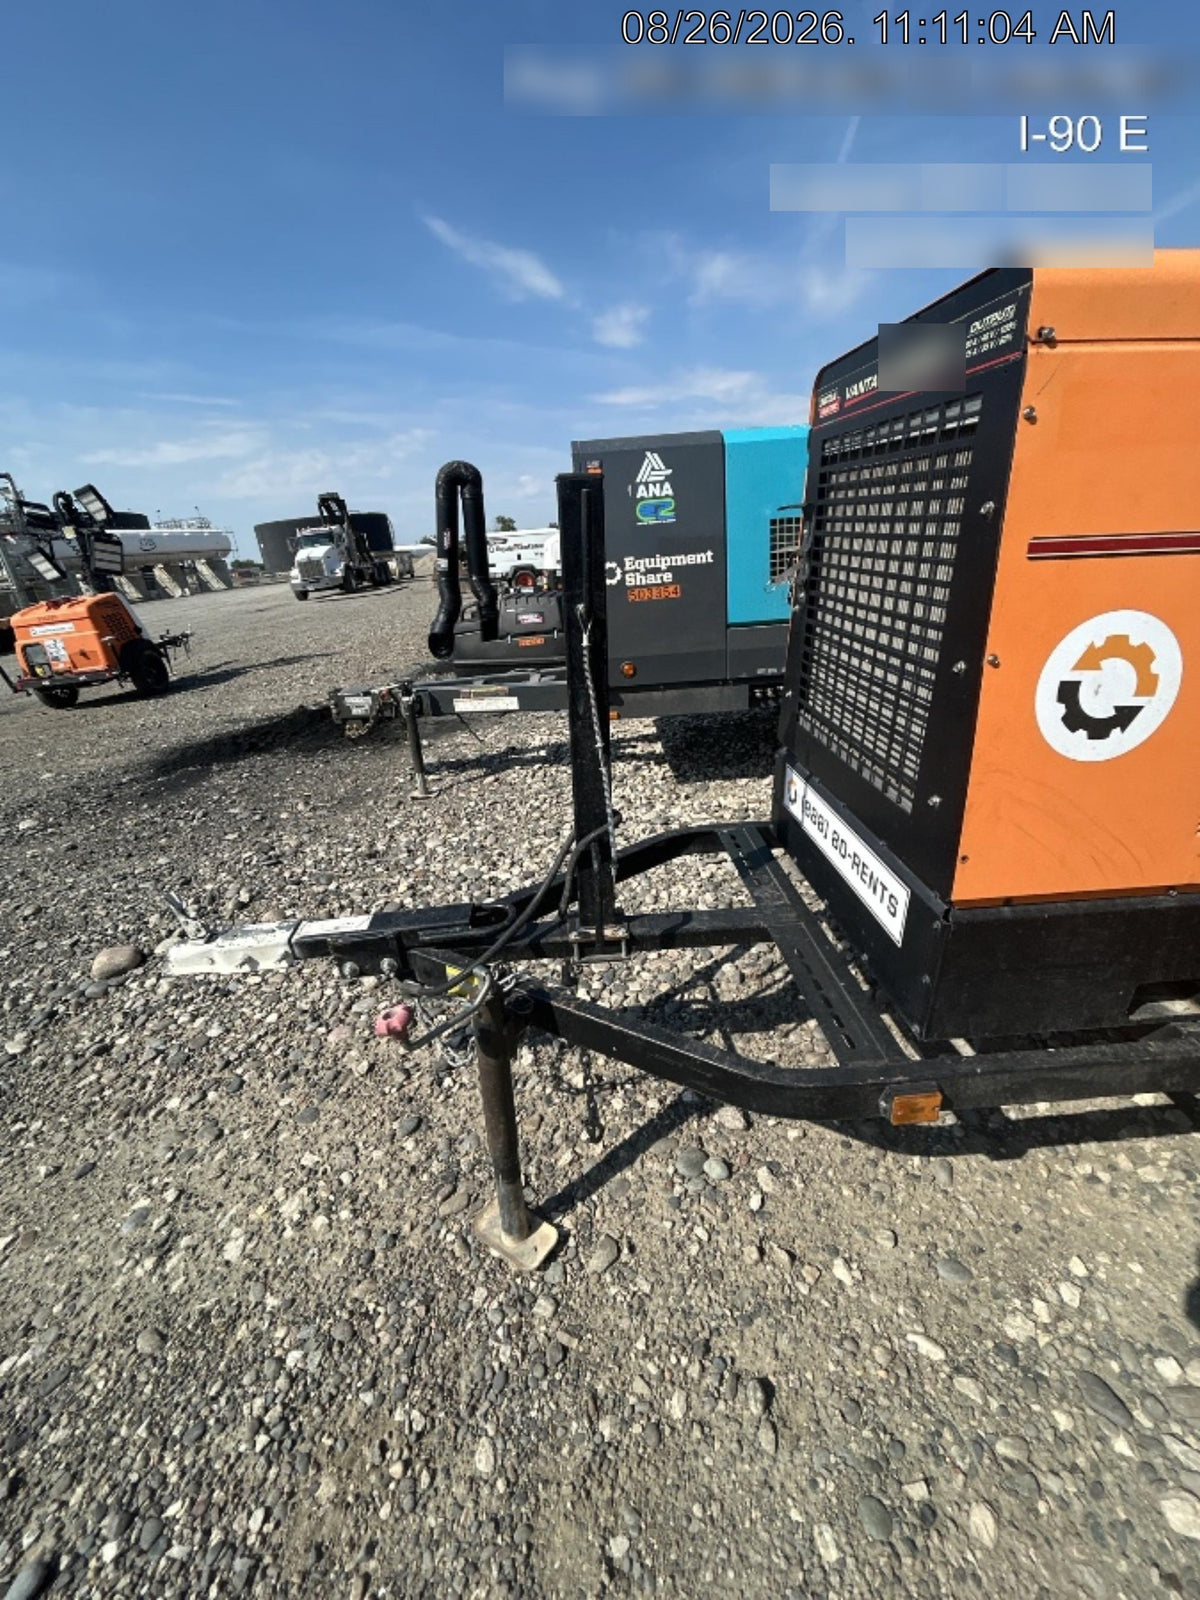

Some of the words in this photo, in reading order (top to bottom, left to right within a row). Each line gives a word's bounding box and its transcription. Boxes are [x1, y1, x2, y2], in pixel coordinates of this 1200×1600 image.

[636, 482, 674, 498] ANA
[624, 550, 714, 572] Equipment
[624, 572, 673, 586] Share
